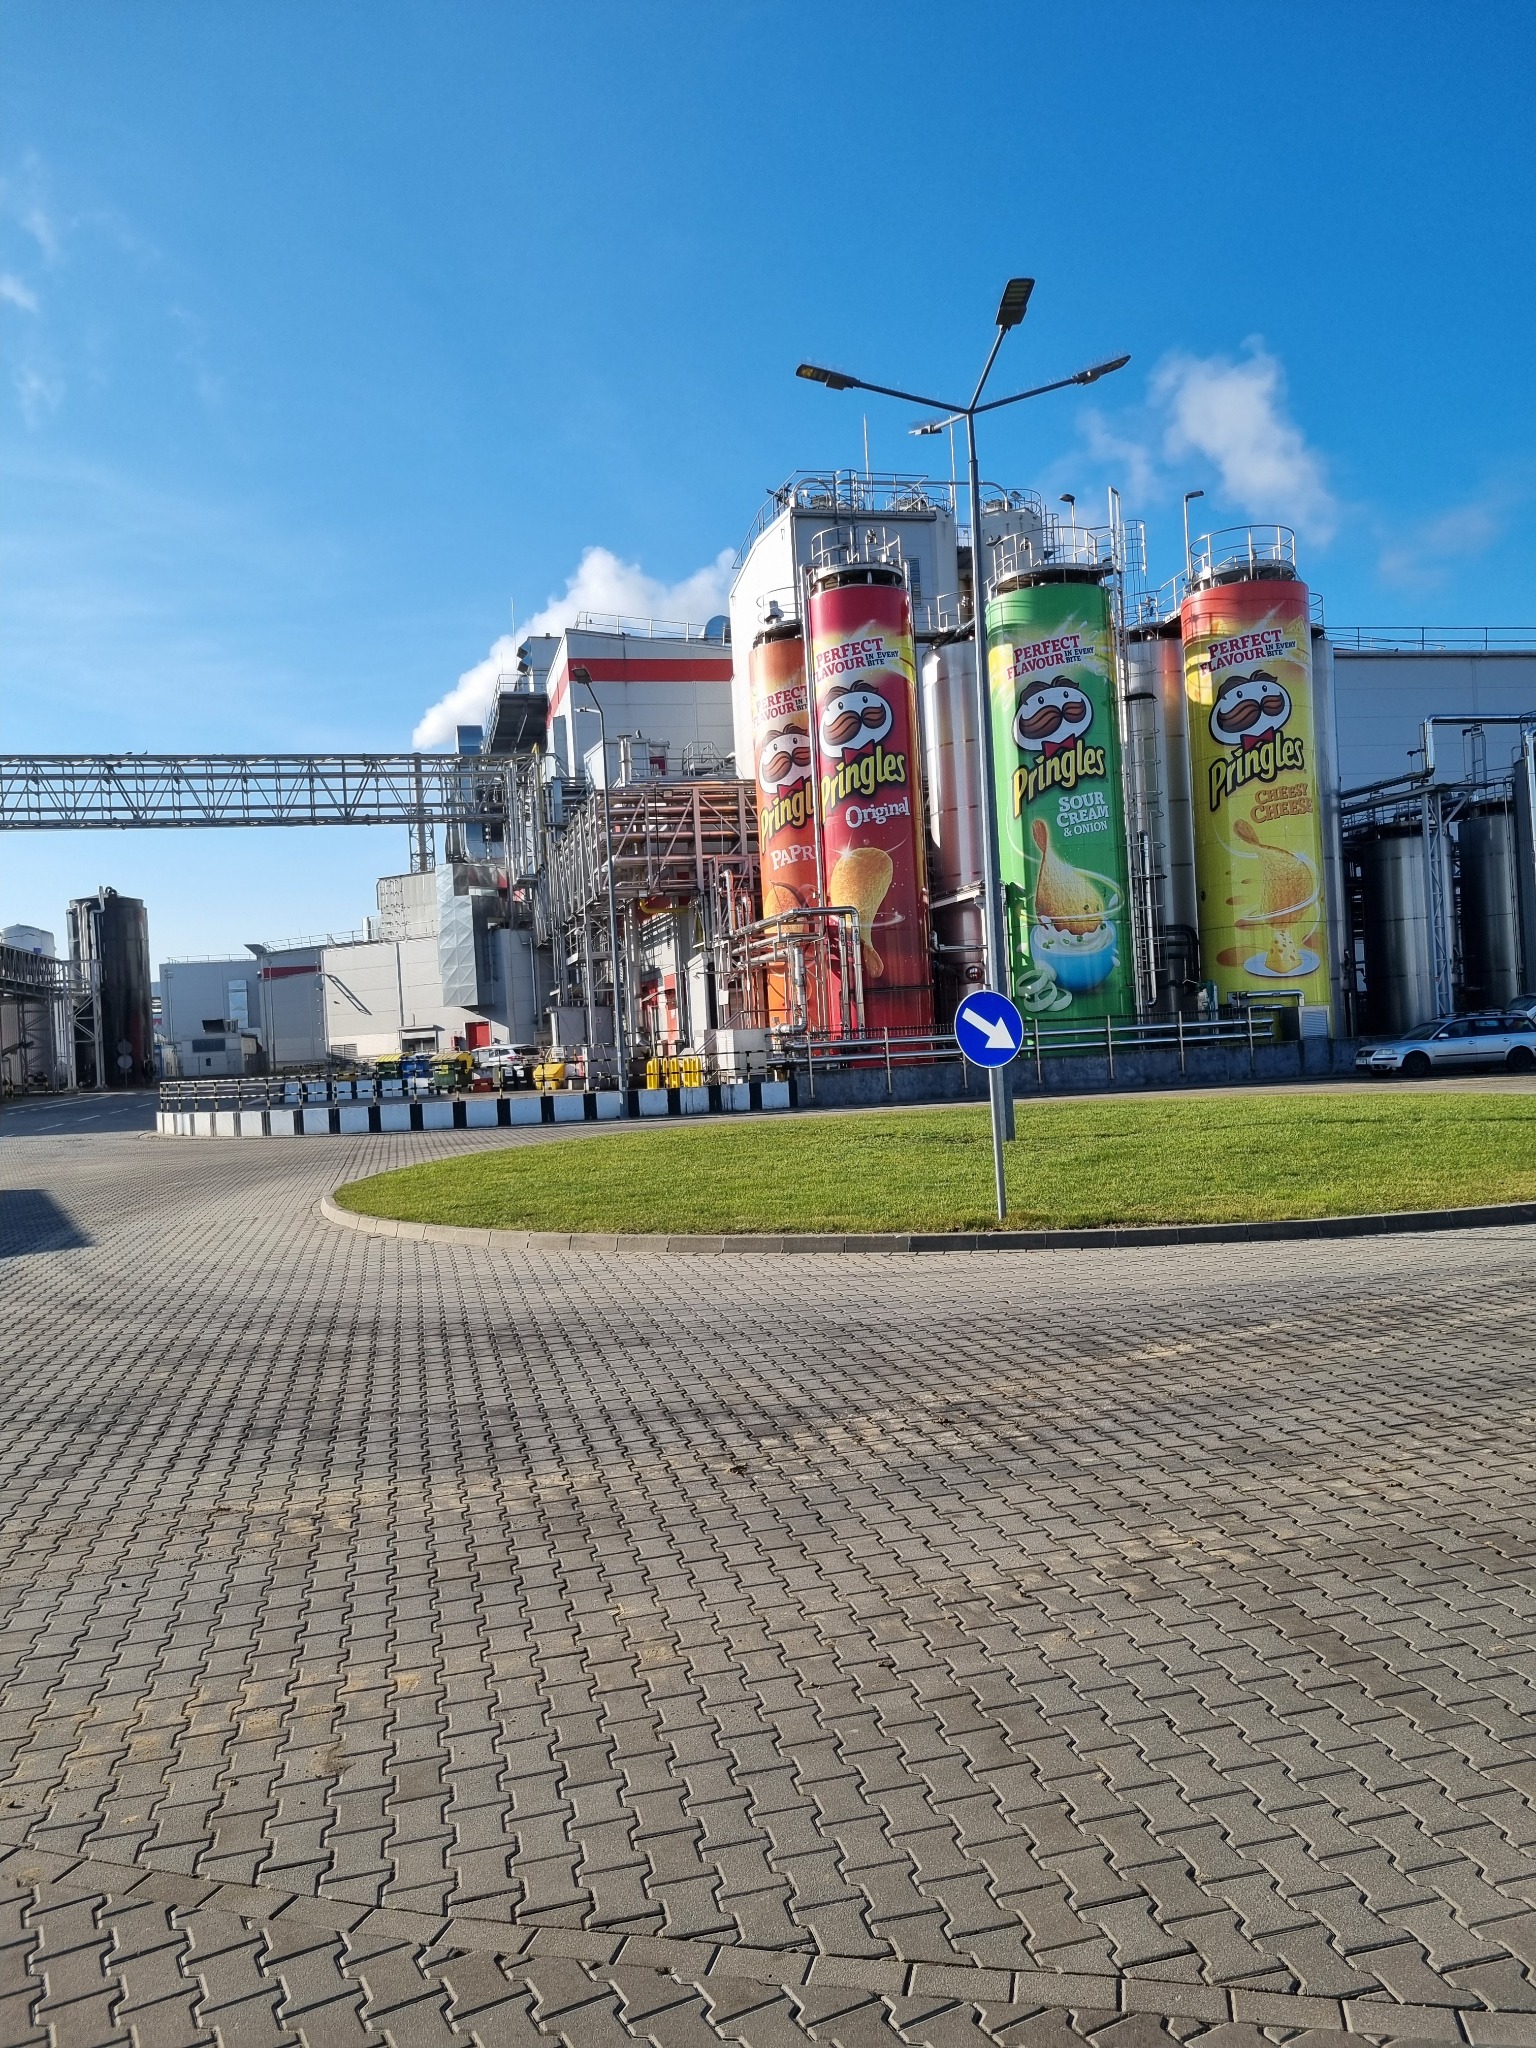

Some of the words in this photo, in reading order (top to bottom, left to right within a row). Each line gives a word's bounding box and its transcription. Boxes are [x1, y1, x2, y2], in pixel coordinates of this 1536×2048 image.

[816, 637, 883, 668] PERFECT
[865, 653, 874, 661] IN
[877, 650, 899, 659] EVERY
[1013, 634, 1080, 664] PERFECT
[1064, 650, 1073, 658] IN
[1074, 646, 1094, 656] EVERY
[1207, 629, 1282, 659] PERFECT
[1265, 644, 1274, 652] IN
[1276, 641, 1296, 650] EVERY
[1266, 649, 1283, 657] BITE
[815, 657, 866, 682] LAVOUR
[866, 658, 885, 667] BITE
[1006, 653, 1065, 680] FLAVOUR
[1066, 655, 1082, 664] BITE
[1200, 647, 1267, 676] FLAVOUR
[1013, 739, 1105, 818] Pringles
[1211, 731, 1303, 810] Pringles
[820, 744, 906, 826] Pringles
[1255, 783, 1309, 804] CHEESY
[846, 797, 910, 828] Original
[1058, 791, 1105, 813] SOUR
[1250, 797, 1313, 823] CHEESE
[761, 781, 815, 855] Pringl
[1056, 805, 1110, 828] CREAM
[1063, 827, 1072, 837] &
[1073, 820, 1108, 835] ONION
